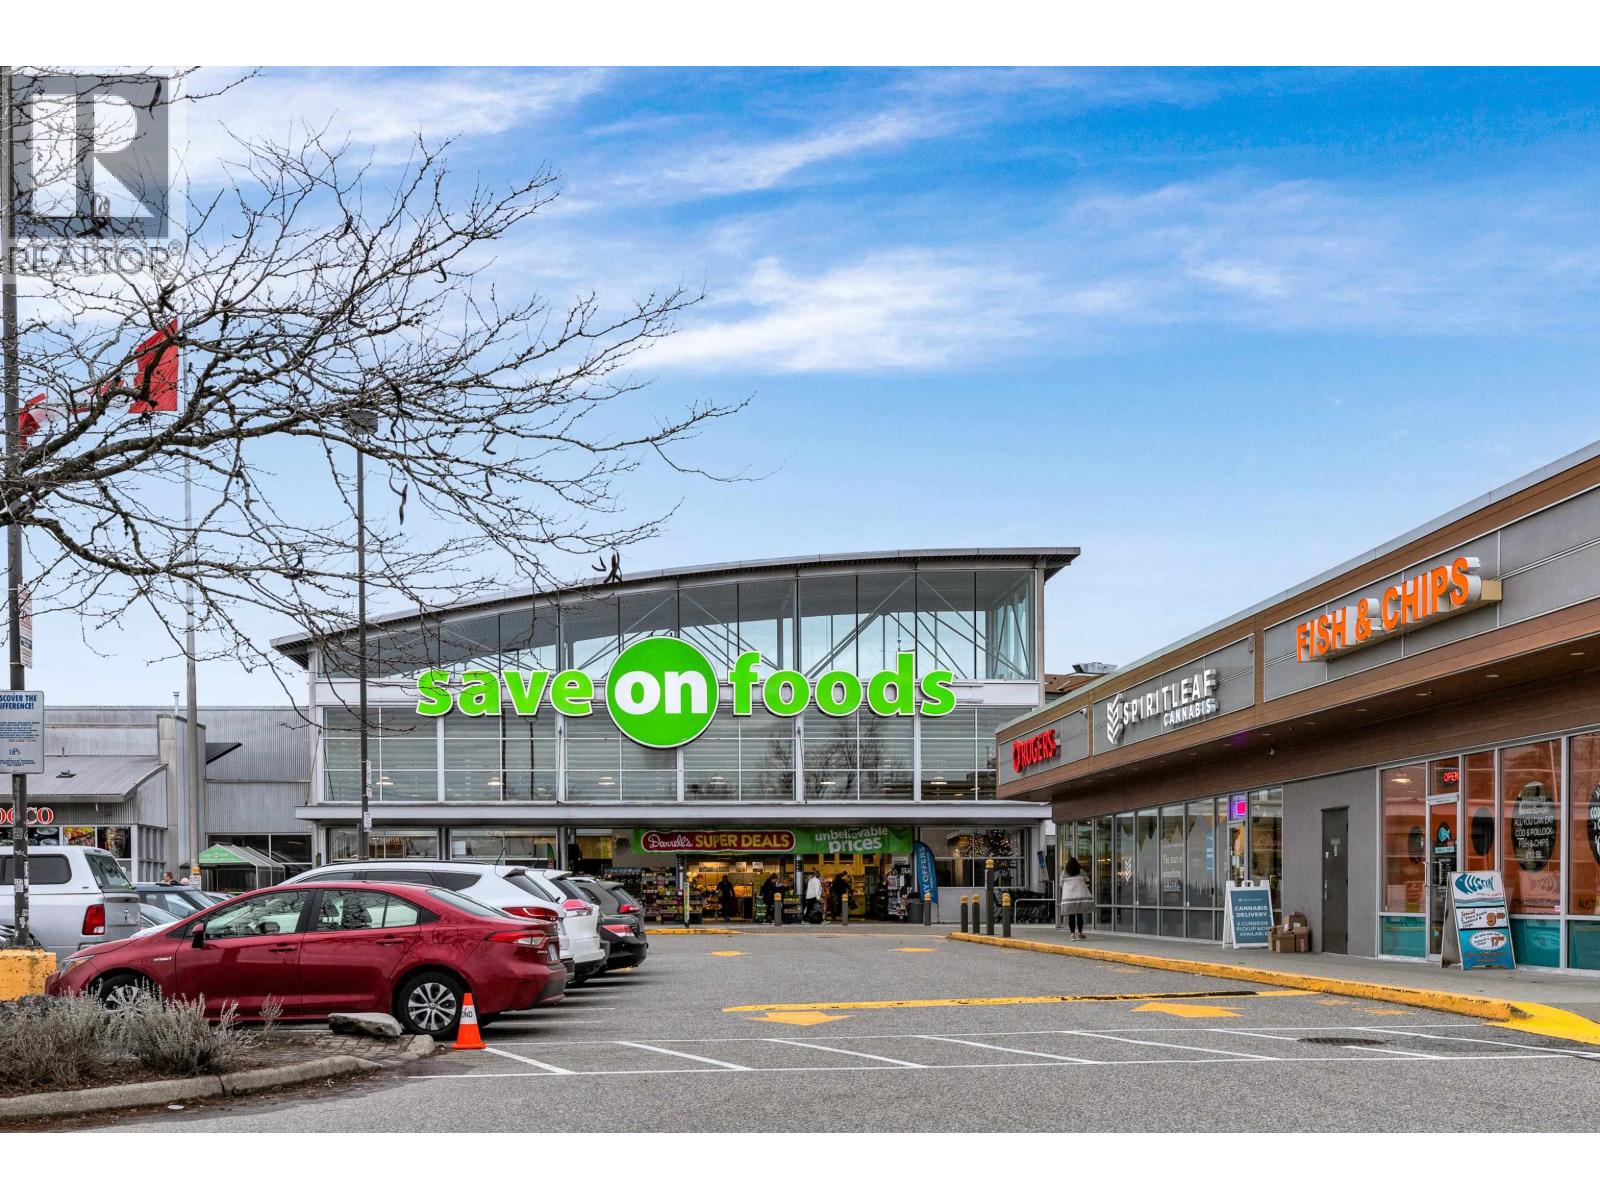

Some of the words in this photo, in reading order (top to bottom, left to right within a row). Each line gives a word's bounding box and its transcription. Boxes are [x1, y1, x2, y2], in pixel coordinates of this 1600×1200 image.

[1297, 607, 1347, 663] FISH
[1355, 598, 1373, 641] &
[1382, 557, 1470, 631] CHIPS
[416, 669, 595, 717] save
[614, 670, 708, 715] on
[728, 651, 957, 717] foods
[1123, 669, 1217, 725] SPIRITLEAF
[1163, 699, 1214, 727] CANNABIS
[1523, 817, 1533, 825] YOU
[1533, 816, 1544, 825] CAN
[1545, 816, 1553, 824] EAT
[815, 826, 889, 841] unbelievable
[1531, 827, 1552, 836] POLLOCK
[648, 834, 693, 848] Darrell's
[695, 834, 738, 848] SUPER
[741, 834, 790, 848] DEALS
[829, 837, 882, 853] prices
